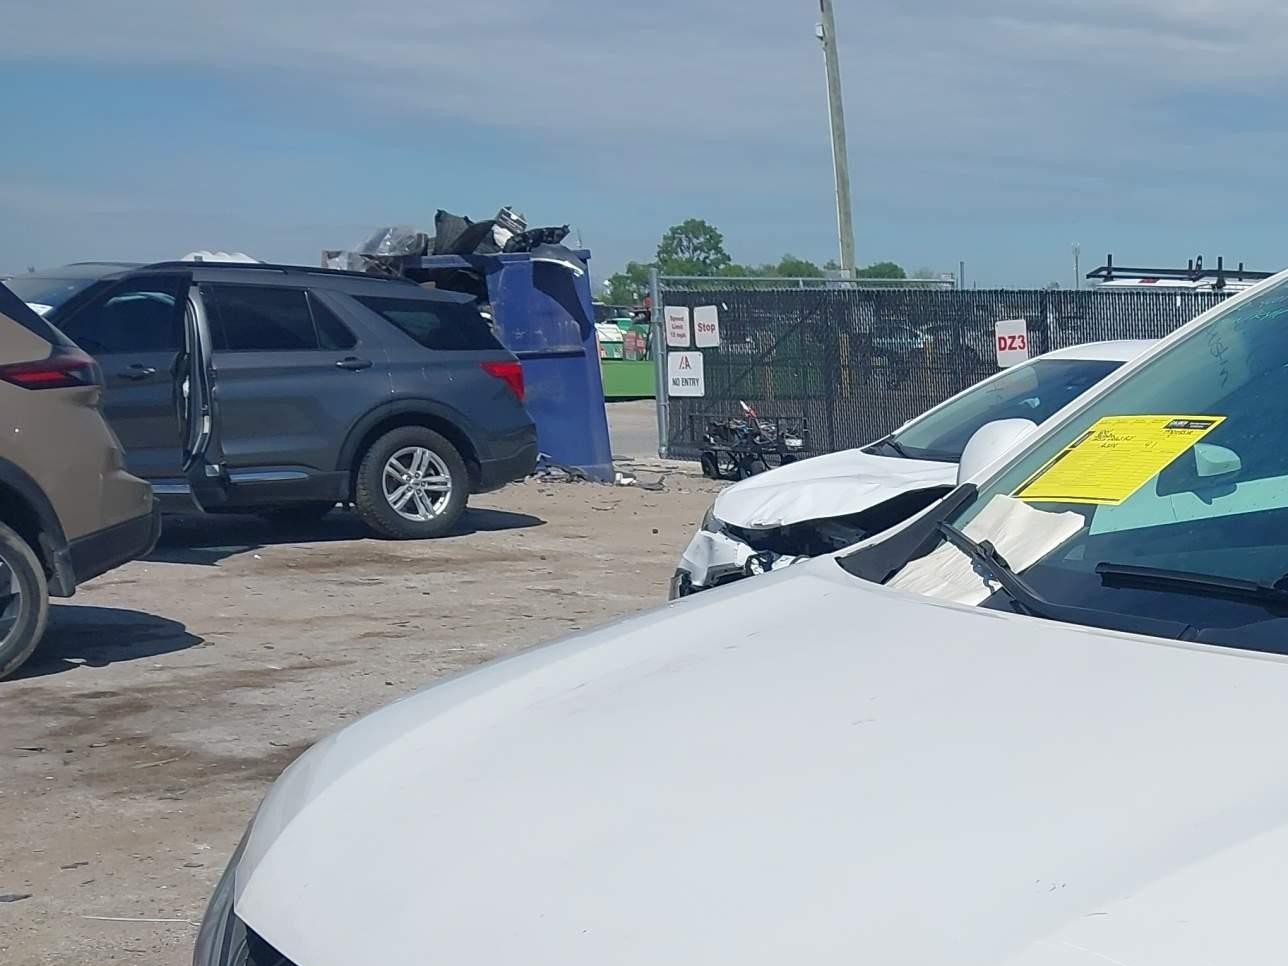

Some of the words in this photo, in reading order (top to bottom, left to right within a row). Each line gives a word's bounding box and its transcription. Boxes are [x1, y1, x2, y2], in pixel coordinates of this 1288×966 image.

[697, 322, 716, 334] Stop
[998, 334, 1026, 351] DZ3
[672, 377, 681, 387] NO
[681, 377, 700, 387] ENTRY
